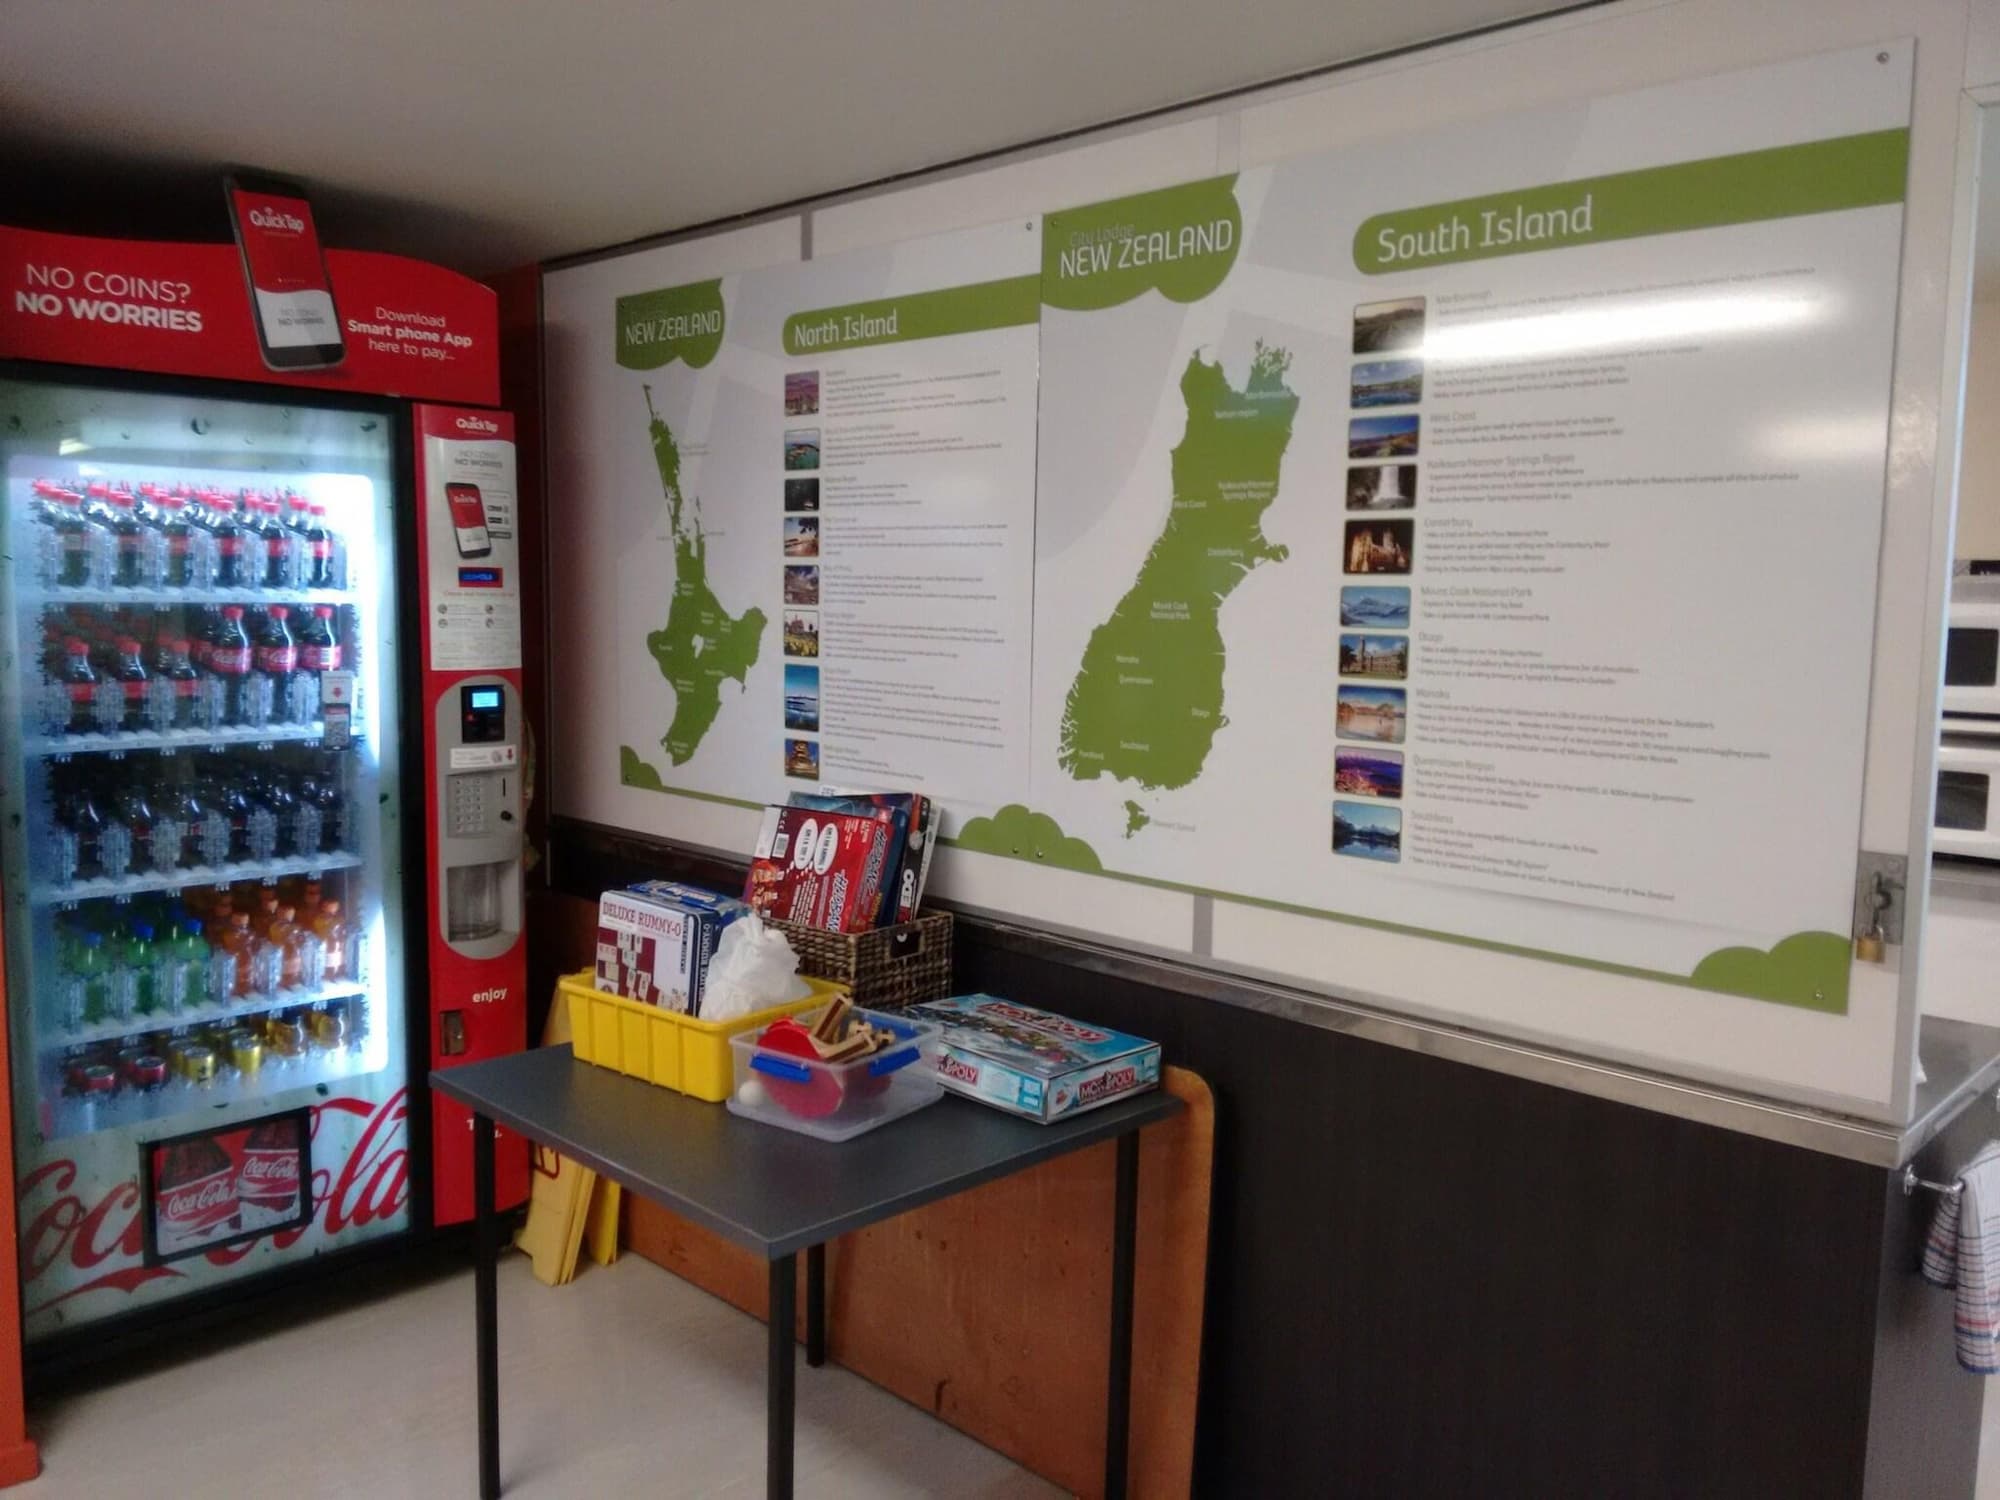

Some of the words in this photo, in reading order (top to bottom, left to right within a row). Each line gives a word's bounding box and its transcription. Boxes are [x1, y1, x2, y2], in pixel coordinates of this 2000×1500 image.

[1377, 216, 1471, 263] South
[1478, 193, 1593, 248] Island
[1060, 242, 1112, 279] NEW
[1117, 219, 1233, 269] ZEALAND
[26, 263, 75, 289] NO
[84, 271, 191, 304] COINS?
[15, 290, 63, 316] NO
[67, 297, 203, 332] WORRIES
[375, 306, 446, 328] Download
[625, 320, 655, 346] NEW
[658, 310, 721, 342] ZEALAND
[794, 320, 839, 347] North
[842, 309, 898, 342] Island
[347, 319, 393, 336] Smart
[394, 326, 441, 343] phone
[443, 332, 473, 347] App
[368, 338, 400, 353] here
[403, 343, 418, 355] to
[602, 902, 636, 923] DELUXE
[638, 912, 681, 937] RUMMY-O
[472, 988, 508, 1003] enjoy
[1080, 1069, 1133, 1101] MOPOLY
